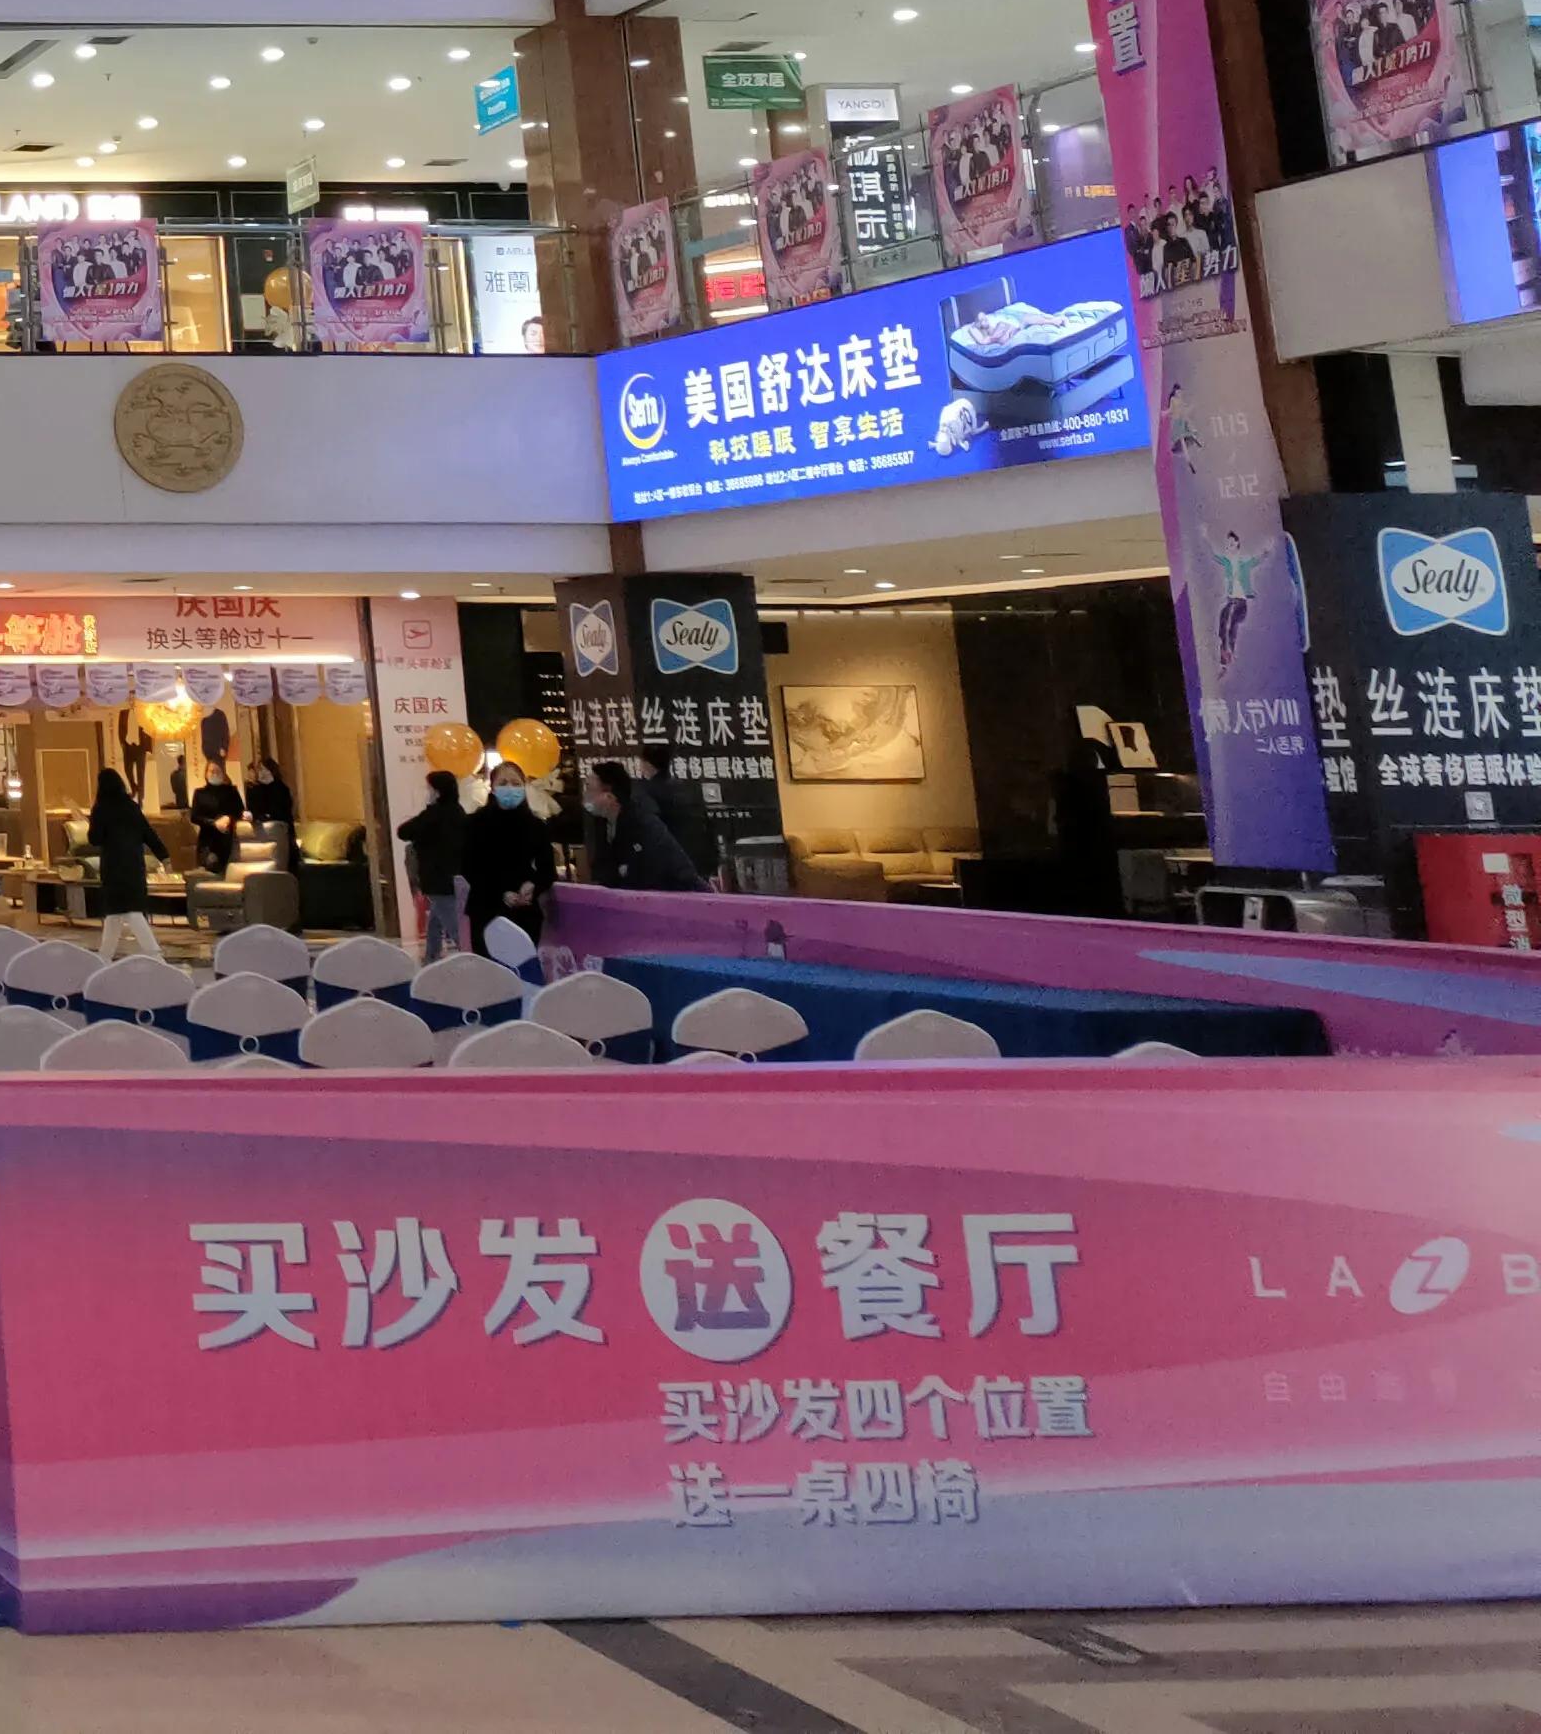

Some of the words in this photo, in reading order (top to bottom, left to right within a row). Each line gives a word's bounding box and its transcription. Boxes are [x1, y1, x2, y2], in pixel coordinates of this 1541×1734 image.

[683, 323, 922, 430] 美国舒达床垫
[628, 391, 660, 426] Serta
[1062, 407, 1130, 431] 400-880-1931
[707, 425, 797, 466] 科技睡眠
[810, 408, 906, 450] 智享生活
[1038, 432, 1097, 451] www.serta.cn
[1403, 559, 1481, 601] Sealy
[146, 627, 314, 651] 换头等舱过十一
[577, 625, 609, 653] Sealy
[665, 620, 719, 651] Sealy
[393, 696, 449, 715] 庆国庆
[571, 696, 637, 748] 丝涟床垫
[640, 696, 771, 748] 丝涟床垫
[660, 1377, 1094, 1446] 买沙发四个位置
[667, 1462, 982, 1530] 送一桌四椅
